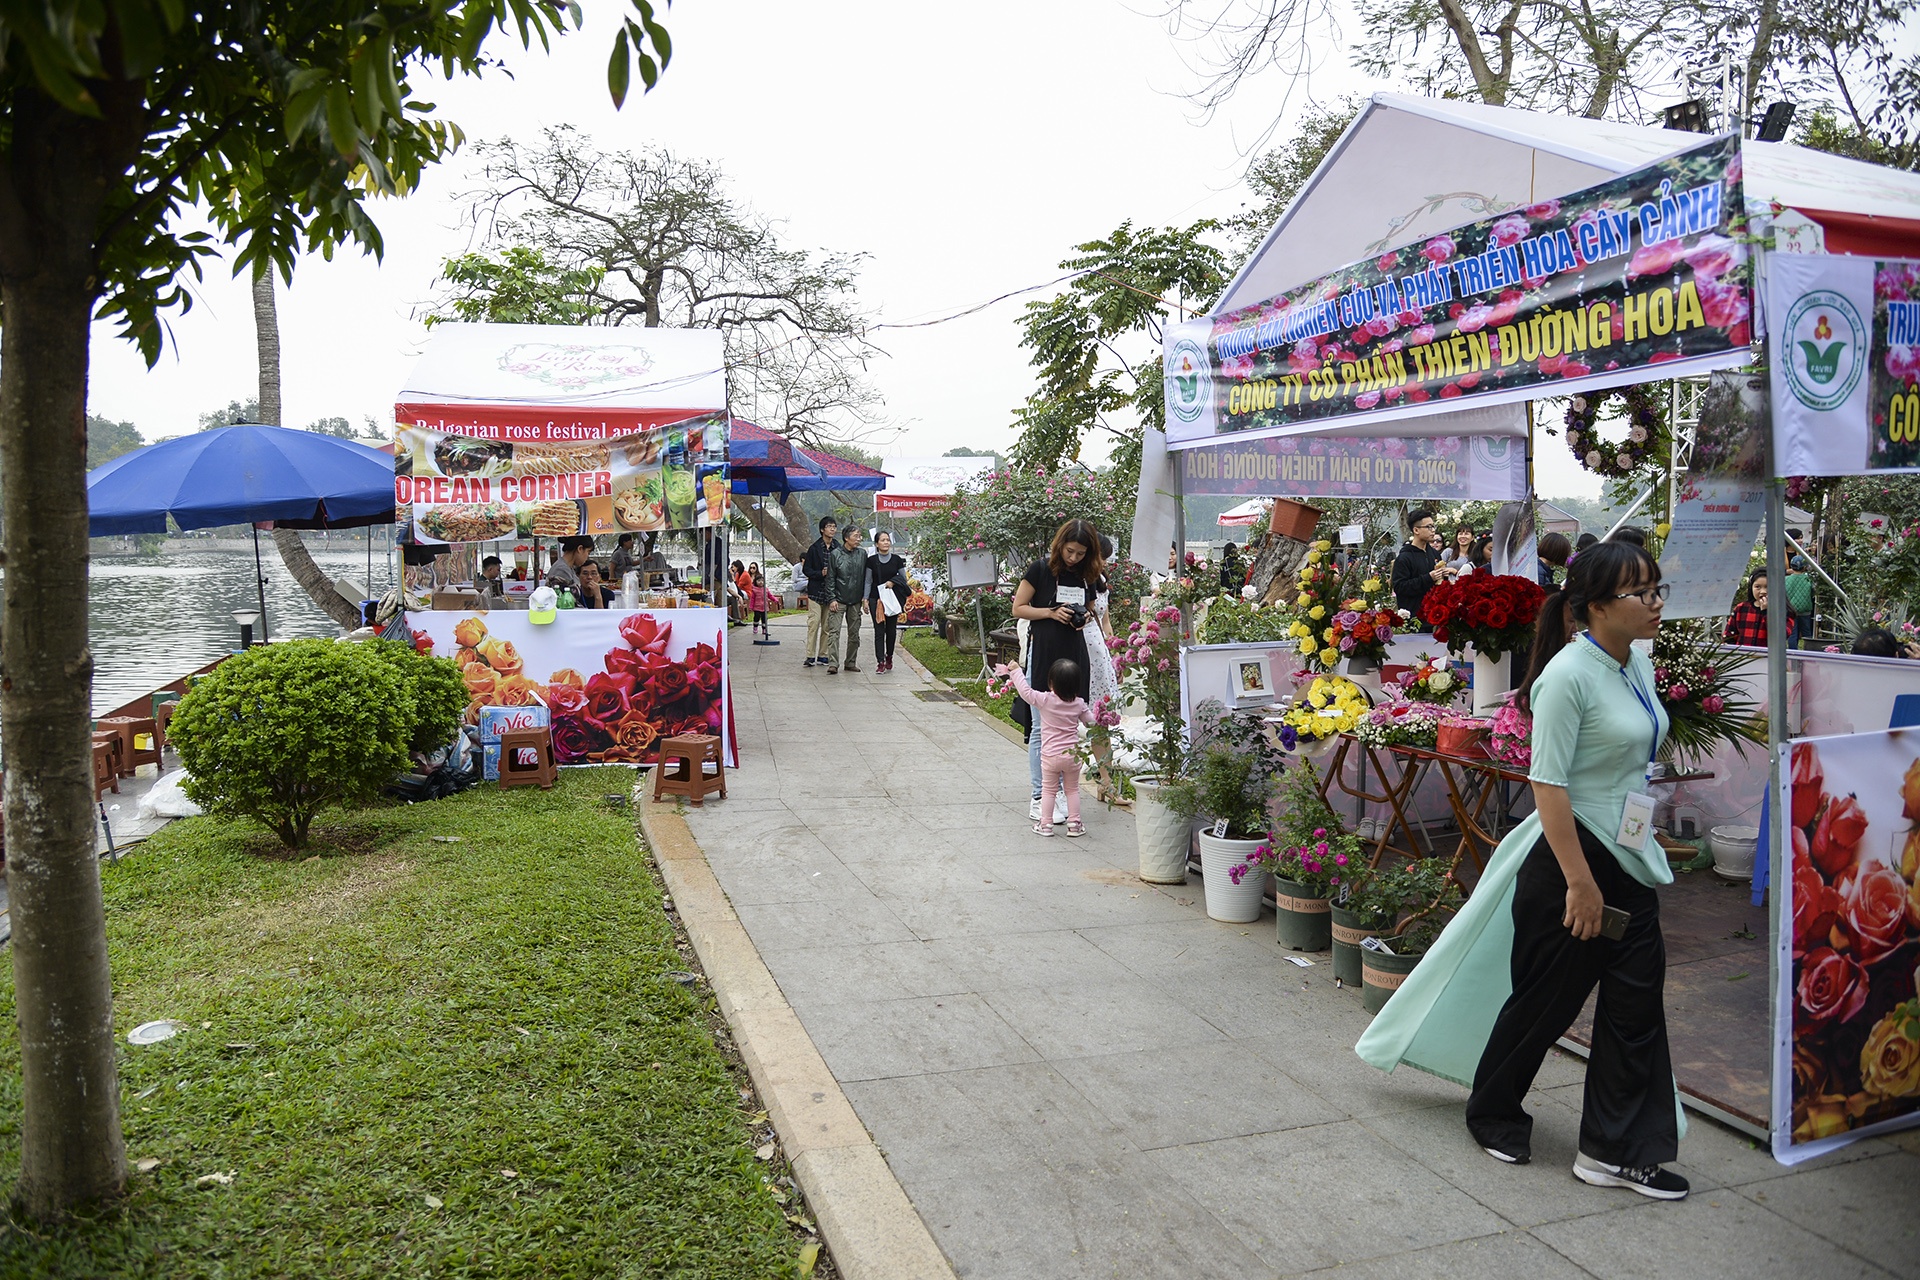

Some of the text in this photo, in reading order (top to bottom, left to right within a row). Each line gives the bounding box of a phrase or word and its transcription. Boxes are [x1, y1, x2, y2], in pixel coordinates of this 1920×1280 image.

[1217, 177, 1723, 360] TRUNG TÂM NGHIÊN CỨU VÀ PHÁT TRIỂN HOA CÂY CẢNH
[1229, 281, 1706, 416] CÔNG TY CỔ PHẦN THIÊN ĐƯỜNG HOA
[1811, 365, 1833, 374] FAVRI
[1888, 383, 1920, 443] CÔ
[505, 426, 540, 439] rose
[546, 421, 607, 439] festival
[500, 471, 613, 504] CORNER
[883, 499, 913, 508] Bulgarian
[1215, 822, 1226, 836] 202
